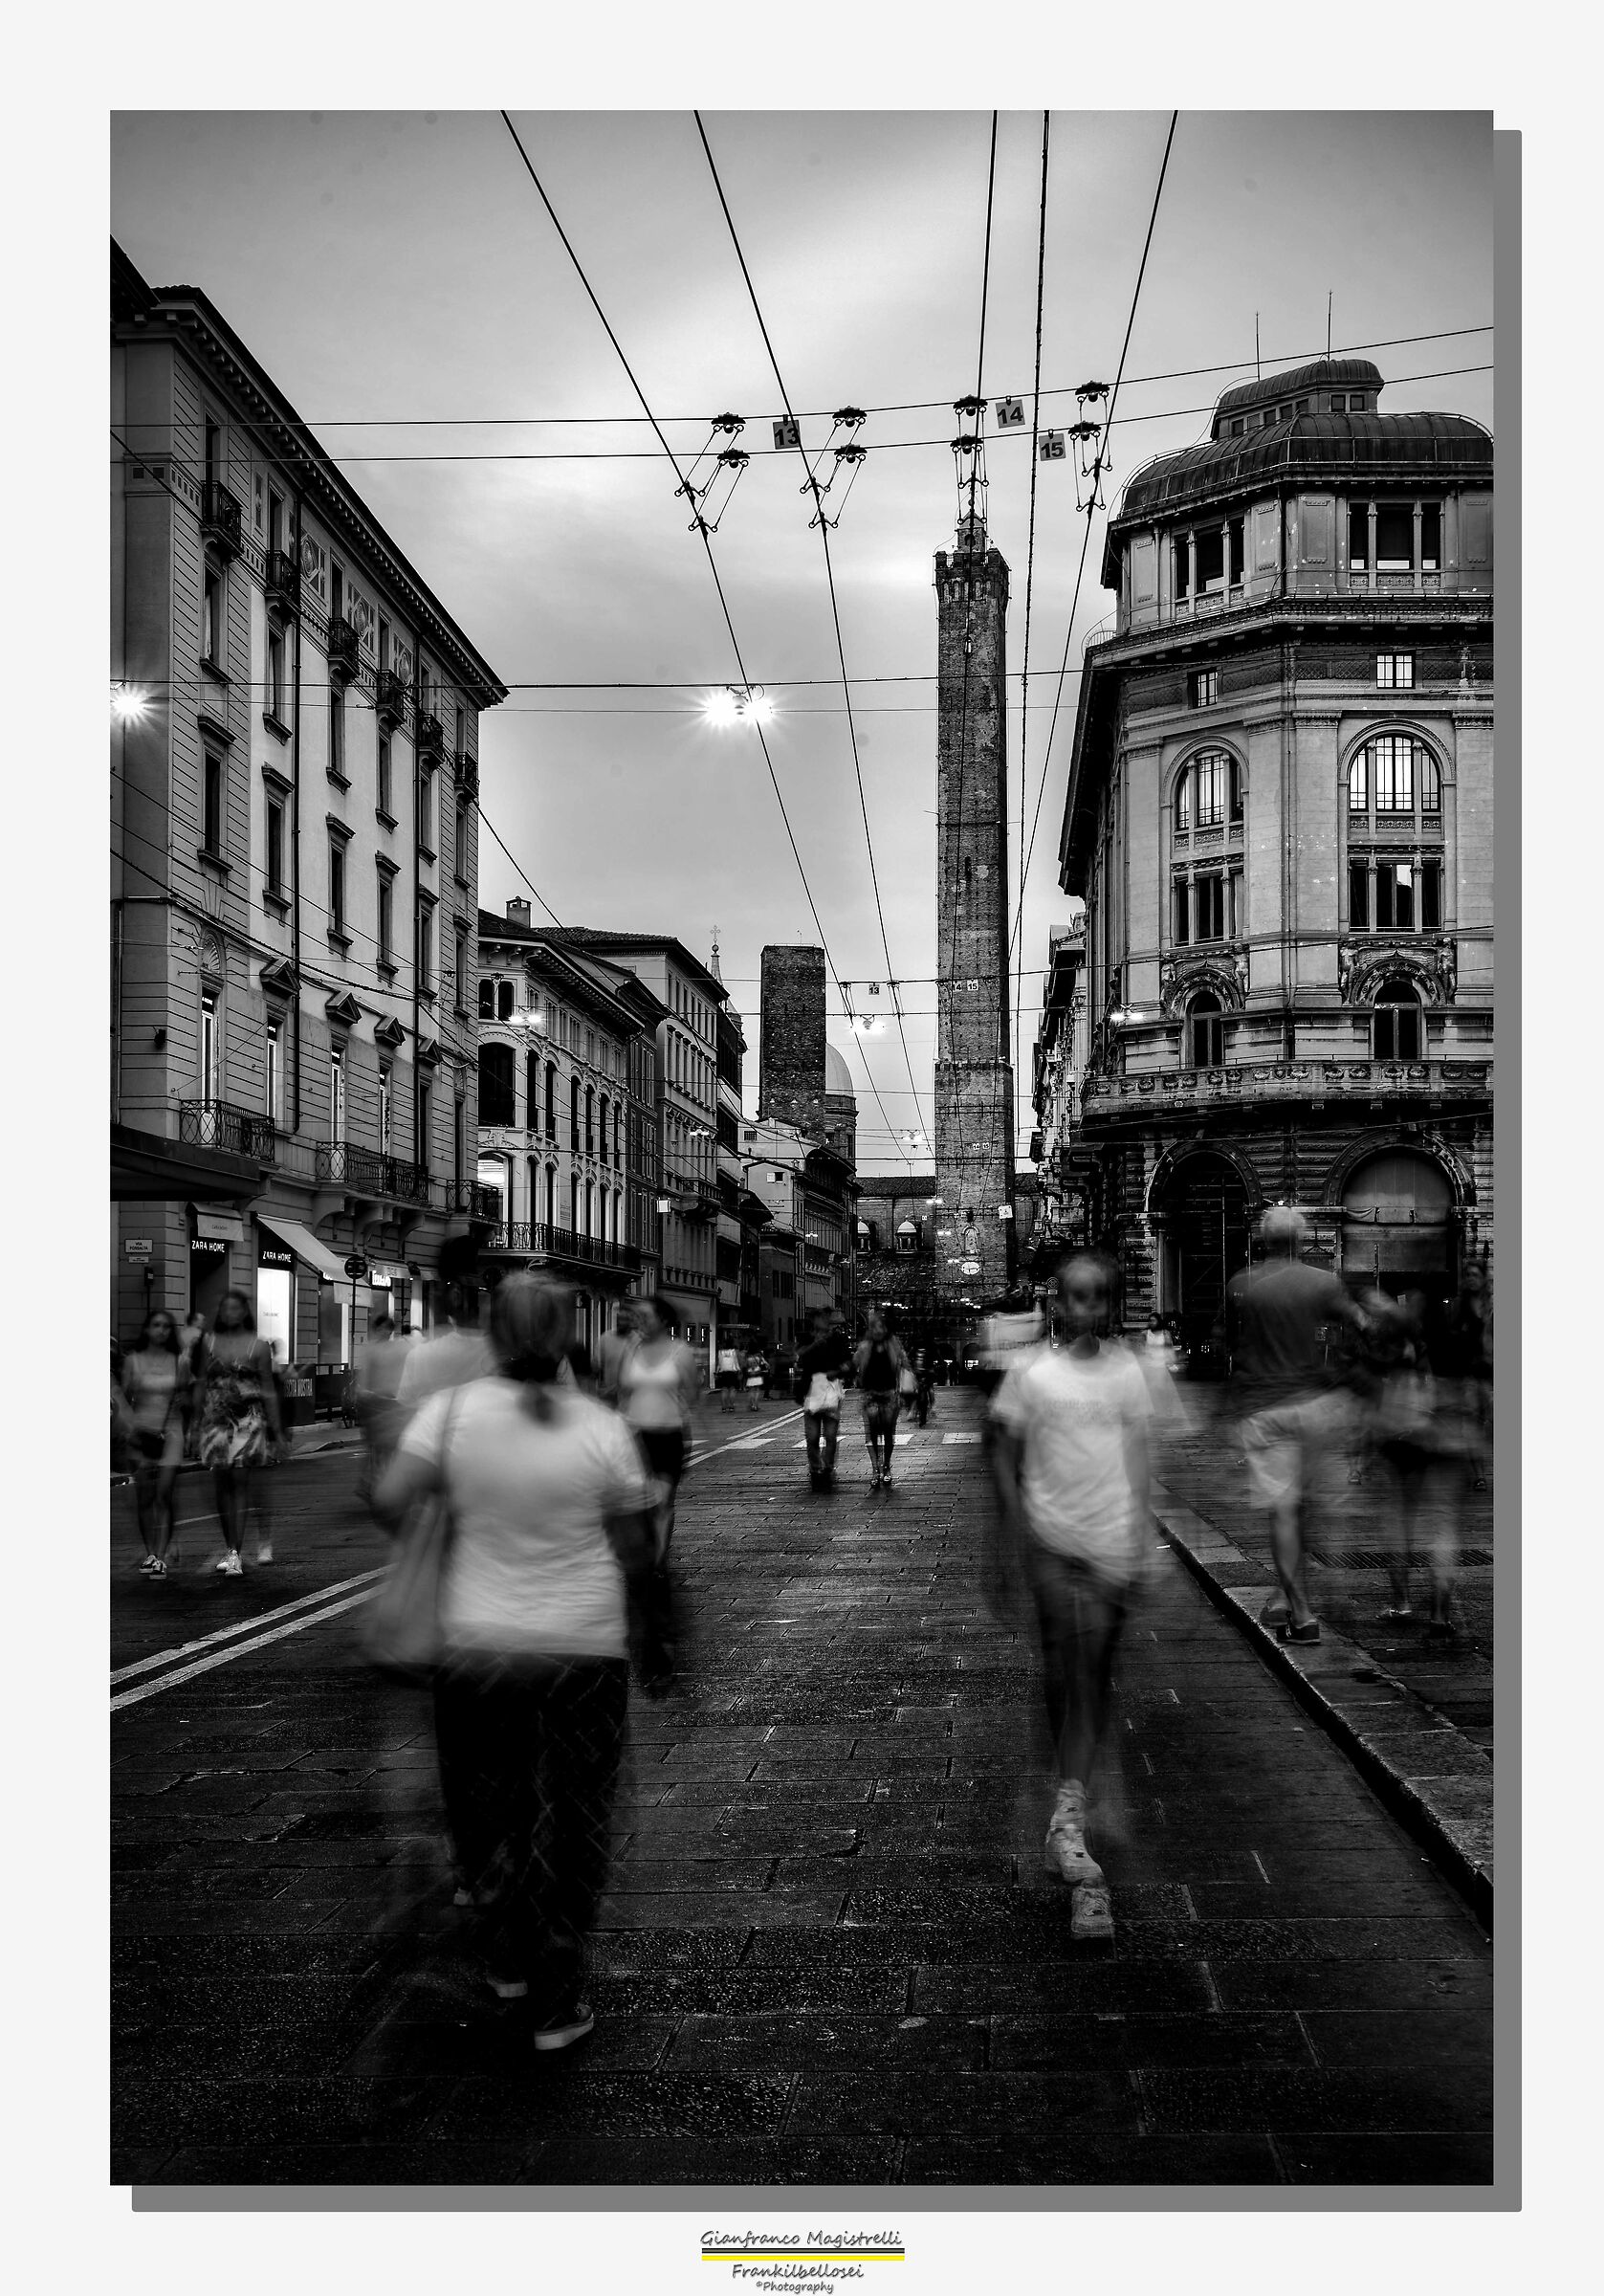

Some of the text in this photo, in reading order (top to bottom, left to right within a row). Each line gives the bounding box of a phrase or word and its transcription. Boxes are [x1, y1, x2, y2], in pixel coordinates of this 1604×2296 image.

[998, 406, 1023, 424] 14
[775, 428, 800, 446] 13
[1041, 442, 1064, 458] 15
[868, 986, 880, 995] 13
[967, 982, 978, 991] 15
[191, 1240, 225, 1253] ZARA HOME
[262, 1250, 292, 1263] ZARA HOME
